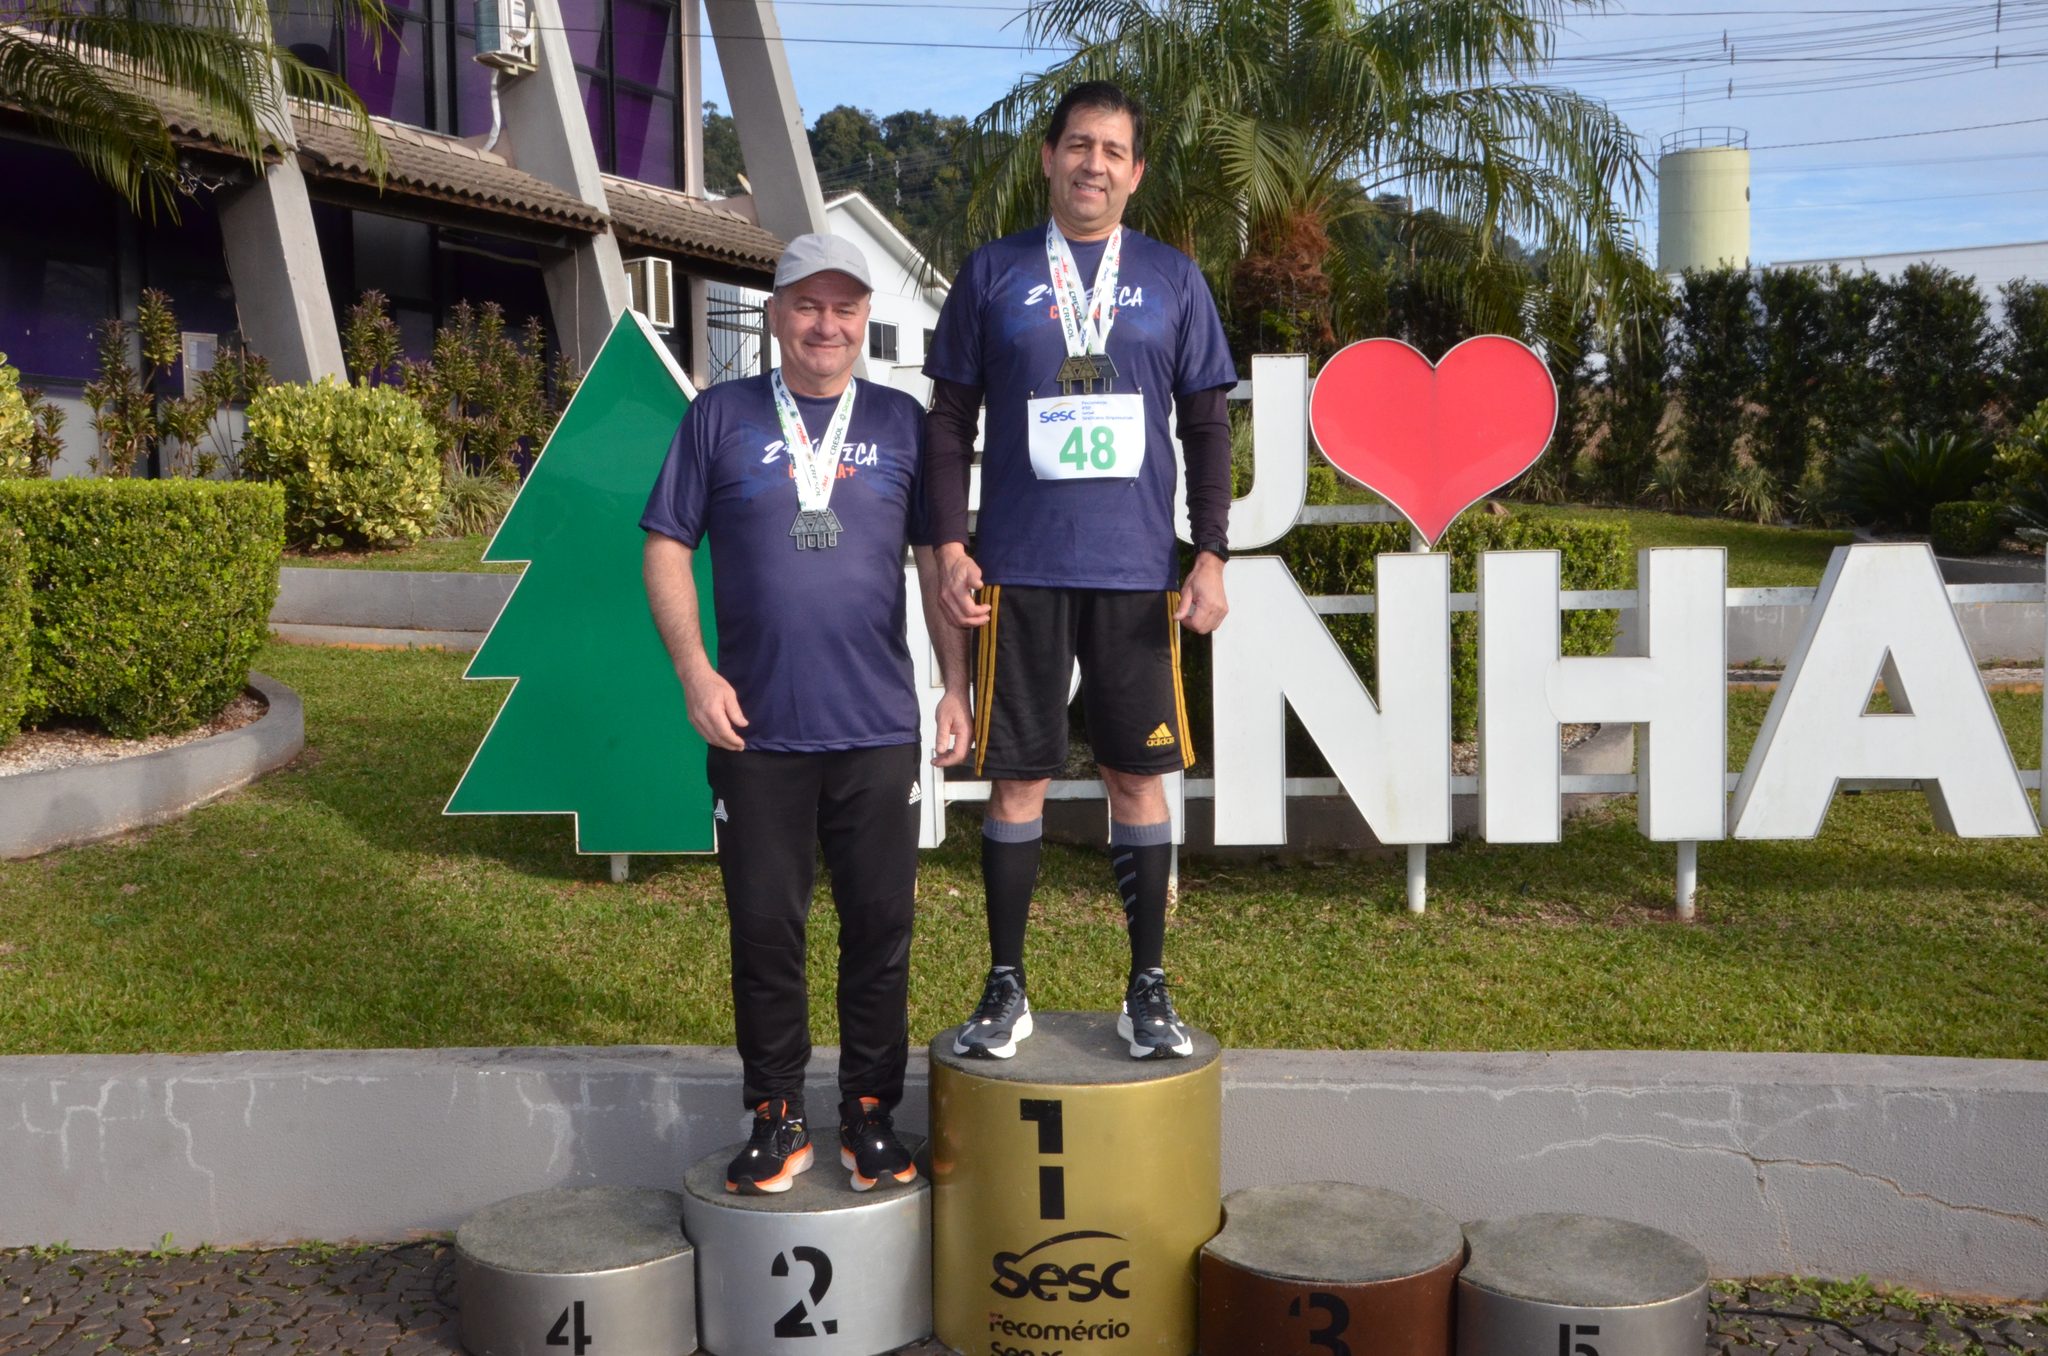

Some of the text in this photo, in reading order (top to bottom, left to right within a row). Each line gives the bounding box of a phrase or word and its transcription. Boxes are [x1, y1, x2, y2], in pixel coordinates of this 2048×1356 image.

[1062, 306, 1075, 339] CRESOL
[829, 426, 844, 456] CRESOL
[1059, 426, 1116, 470] 48
[1146, 736, 1175, 747] adidas
[1020, 1098, 1066, 1220] 1
[771, 1246, 838, 1338] 2
[546, 1300, 592, 1356] 4
[1289, 1292, 1351, 1356] 3
